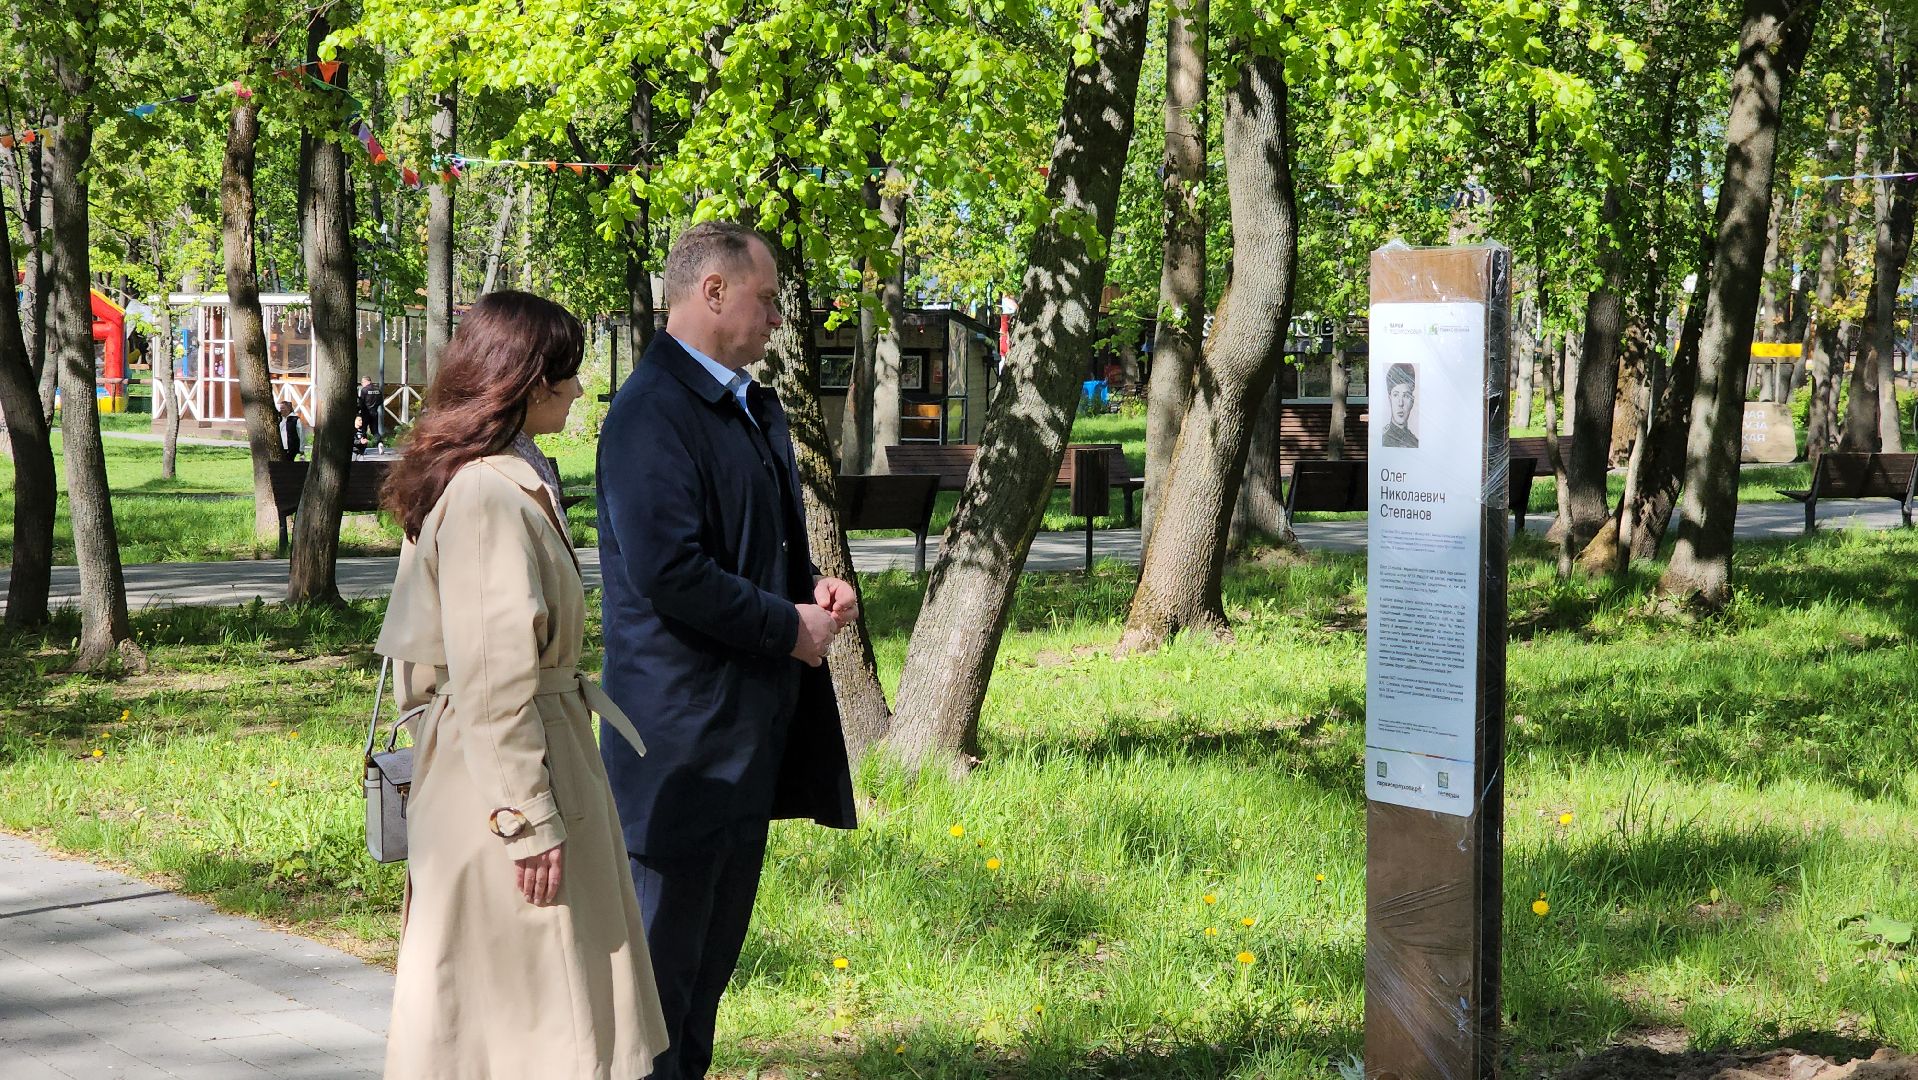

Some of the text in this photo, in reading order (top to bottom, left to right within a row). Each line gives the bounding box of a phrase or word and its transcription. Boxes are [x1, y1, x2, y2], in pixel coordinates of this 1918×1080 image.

[1380, 468, 1407, 482] Олег
[1380, 486, 1446, 504] Николаевич
[1380, 503, 1432, 521] Степанов
